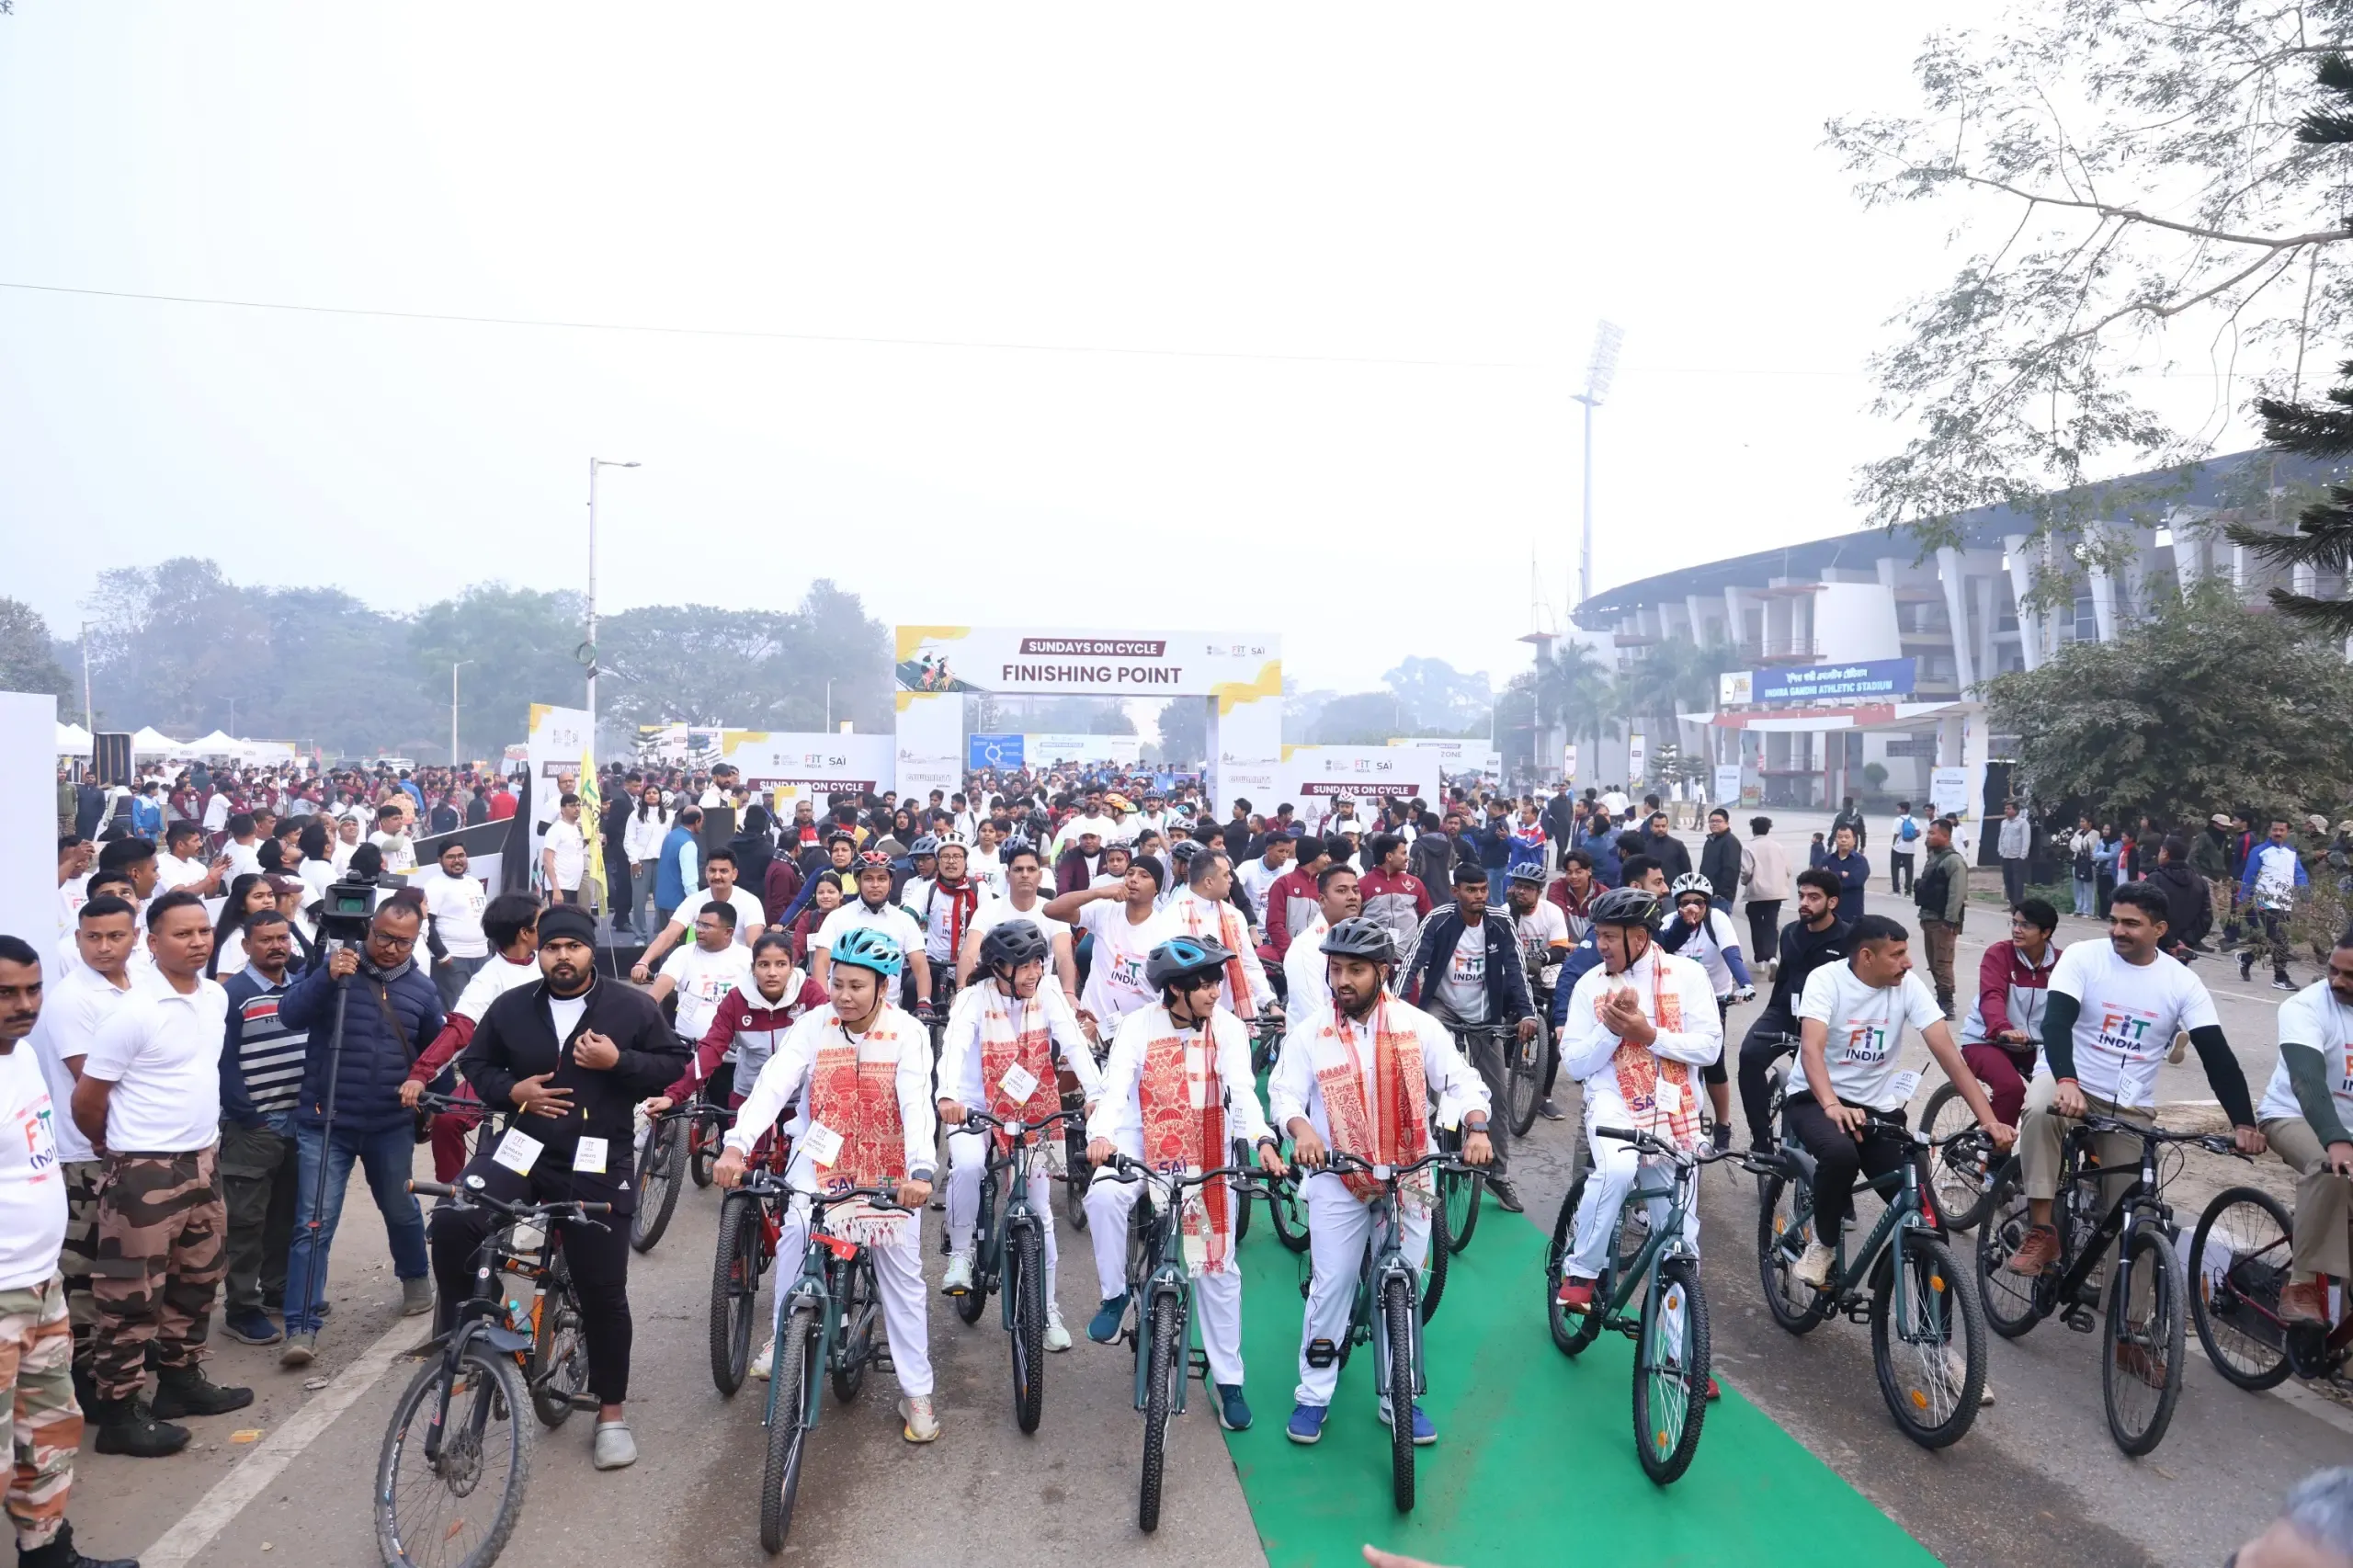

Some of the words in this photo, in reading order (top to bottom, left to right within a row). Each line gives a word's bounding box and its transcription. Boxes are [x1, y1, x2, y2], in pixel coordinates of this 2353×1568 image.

[1029, 640, 1092, 653] SUNDAYS
[1094, 641, 1114, 653] ON
[1116, 642, 1157, 654] CYCLE
[1251, 646, 1265, 654] SAI
[1003, 665, 1112, 683] FINISHING
[1118, 666, 1182, 684] POINT
[1765, 688, 1789, 698] INDIRA
[1790, 686, 1817, 696] GANDHI
[1819, 683, 1855, 694] ATHLETIC
[1857, 680, 1893, 691] STADIUM
[805, 754, 823, 763] FIT
[829, 756, 846, 766] SAI
[1355, 759, 1370, 768] FIT
[1377, 760, 1392, 770] SAI
[812, 782, 828, 791] ON
[830, 783, 864, 791] CYCLE
[1313, 785, 1359, 794] SUNDAYS
[1361, 786, 1376, 794] ON
[1378, 786, 1409, 795] CYCLE
[1114, 954, 1142, 978] FIT
[1455, 957, 1483, 971] FIT
[1454, 972, 1483, 981] INDIA
[701, 981, 732, 995] FIT
[2102, 1014, 2151, 1040] FIT
[1849, 1026, 1885, 1050] FIT
[2098, 1034, 2141, 1051] INDIA
[1846, 1049, 1885, 1062] INDIA
[1633, 1095, 1656, 1111] SA
[25, 1109, 54, 1153] FIT
[1029, 1142, 1055, 1154] INDA
[30, 1144, 57, 1169] INDI
[1159, 1157, 1187, 1175] SAI
[828, 1176, 855, 1194] SAI
